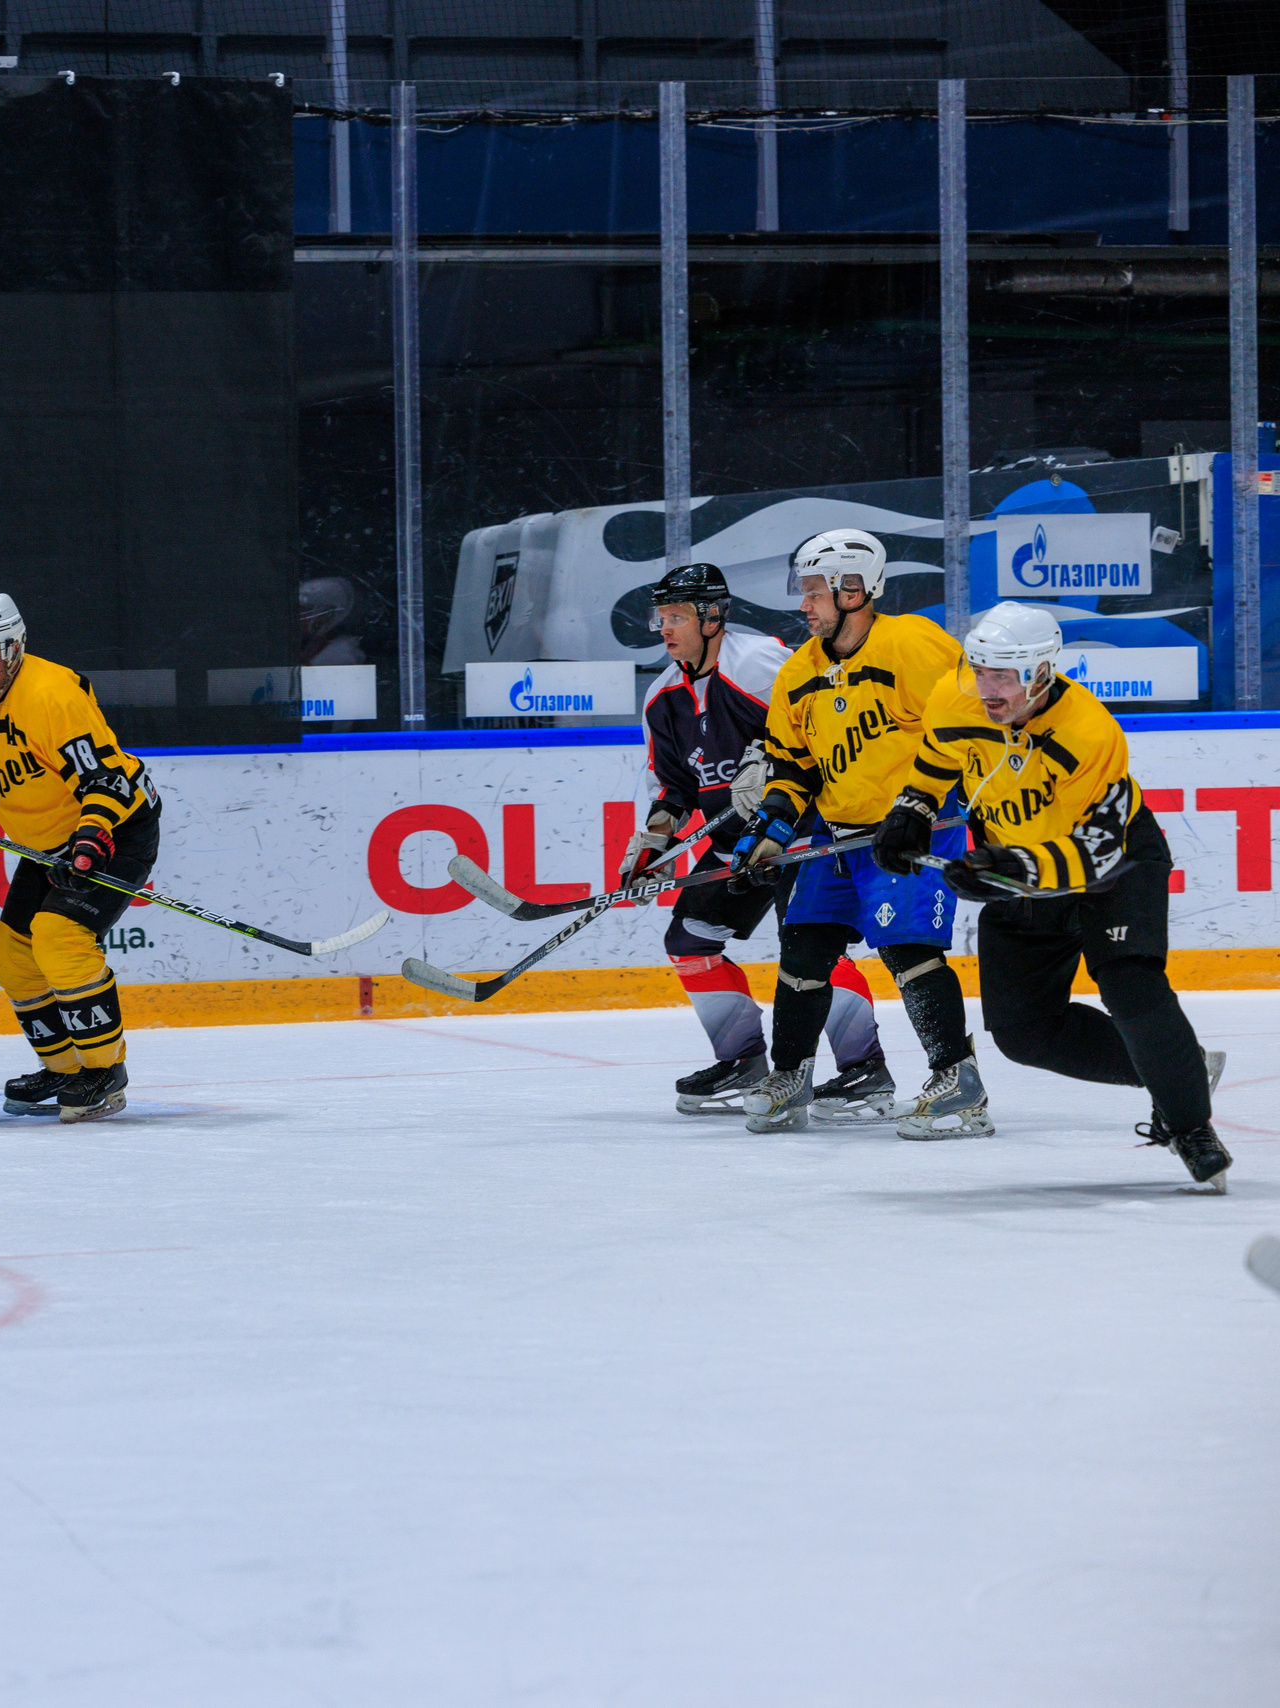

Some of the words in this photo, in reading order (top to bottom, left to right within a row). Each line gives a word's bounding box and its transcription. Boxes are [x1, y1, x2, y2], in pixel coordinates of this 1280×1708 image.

[1051, 562, 1140, 588] ГАЗПРОМ
[534, 694, 593, 712] ГАЗПРОМ
[64, 739, 99, 776] 18
[594, 879, 676, 907] BAUER
[135, 888, 237, 927] FISCHER
